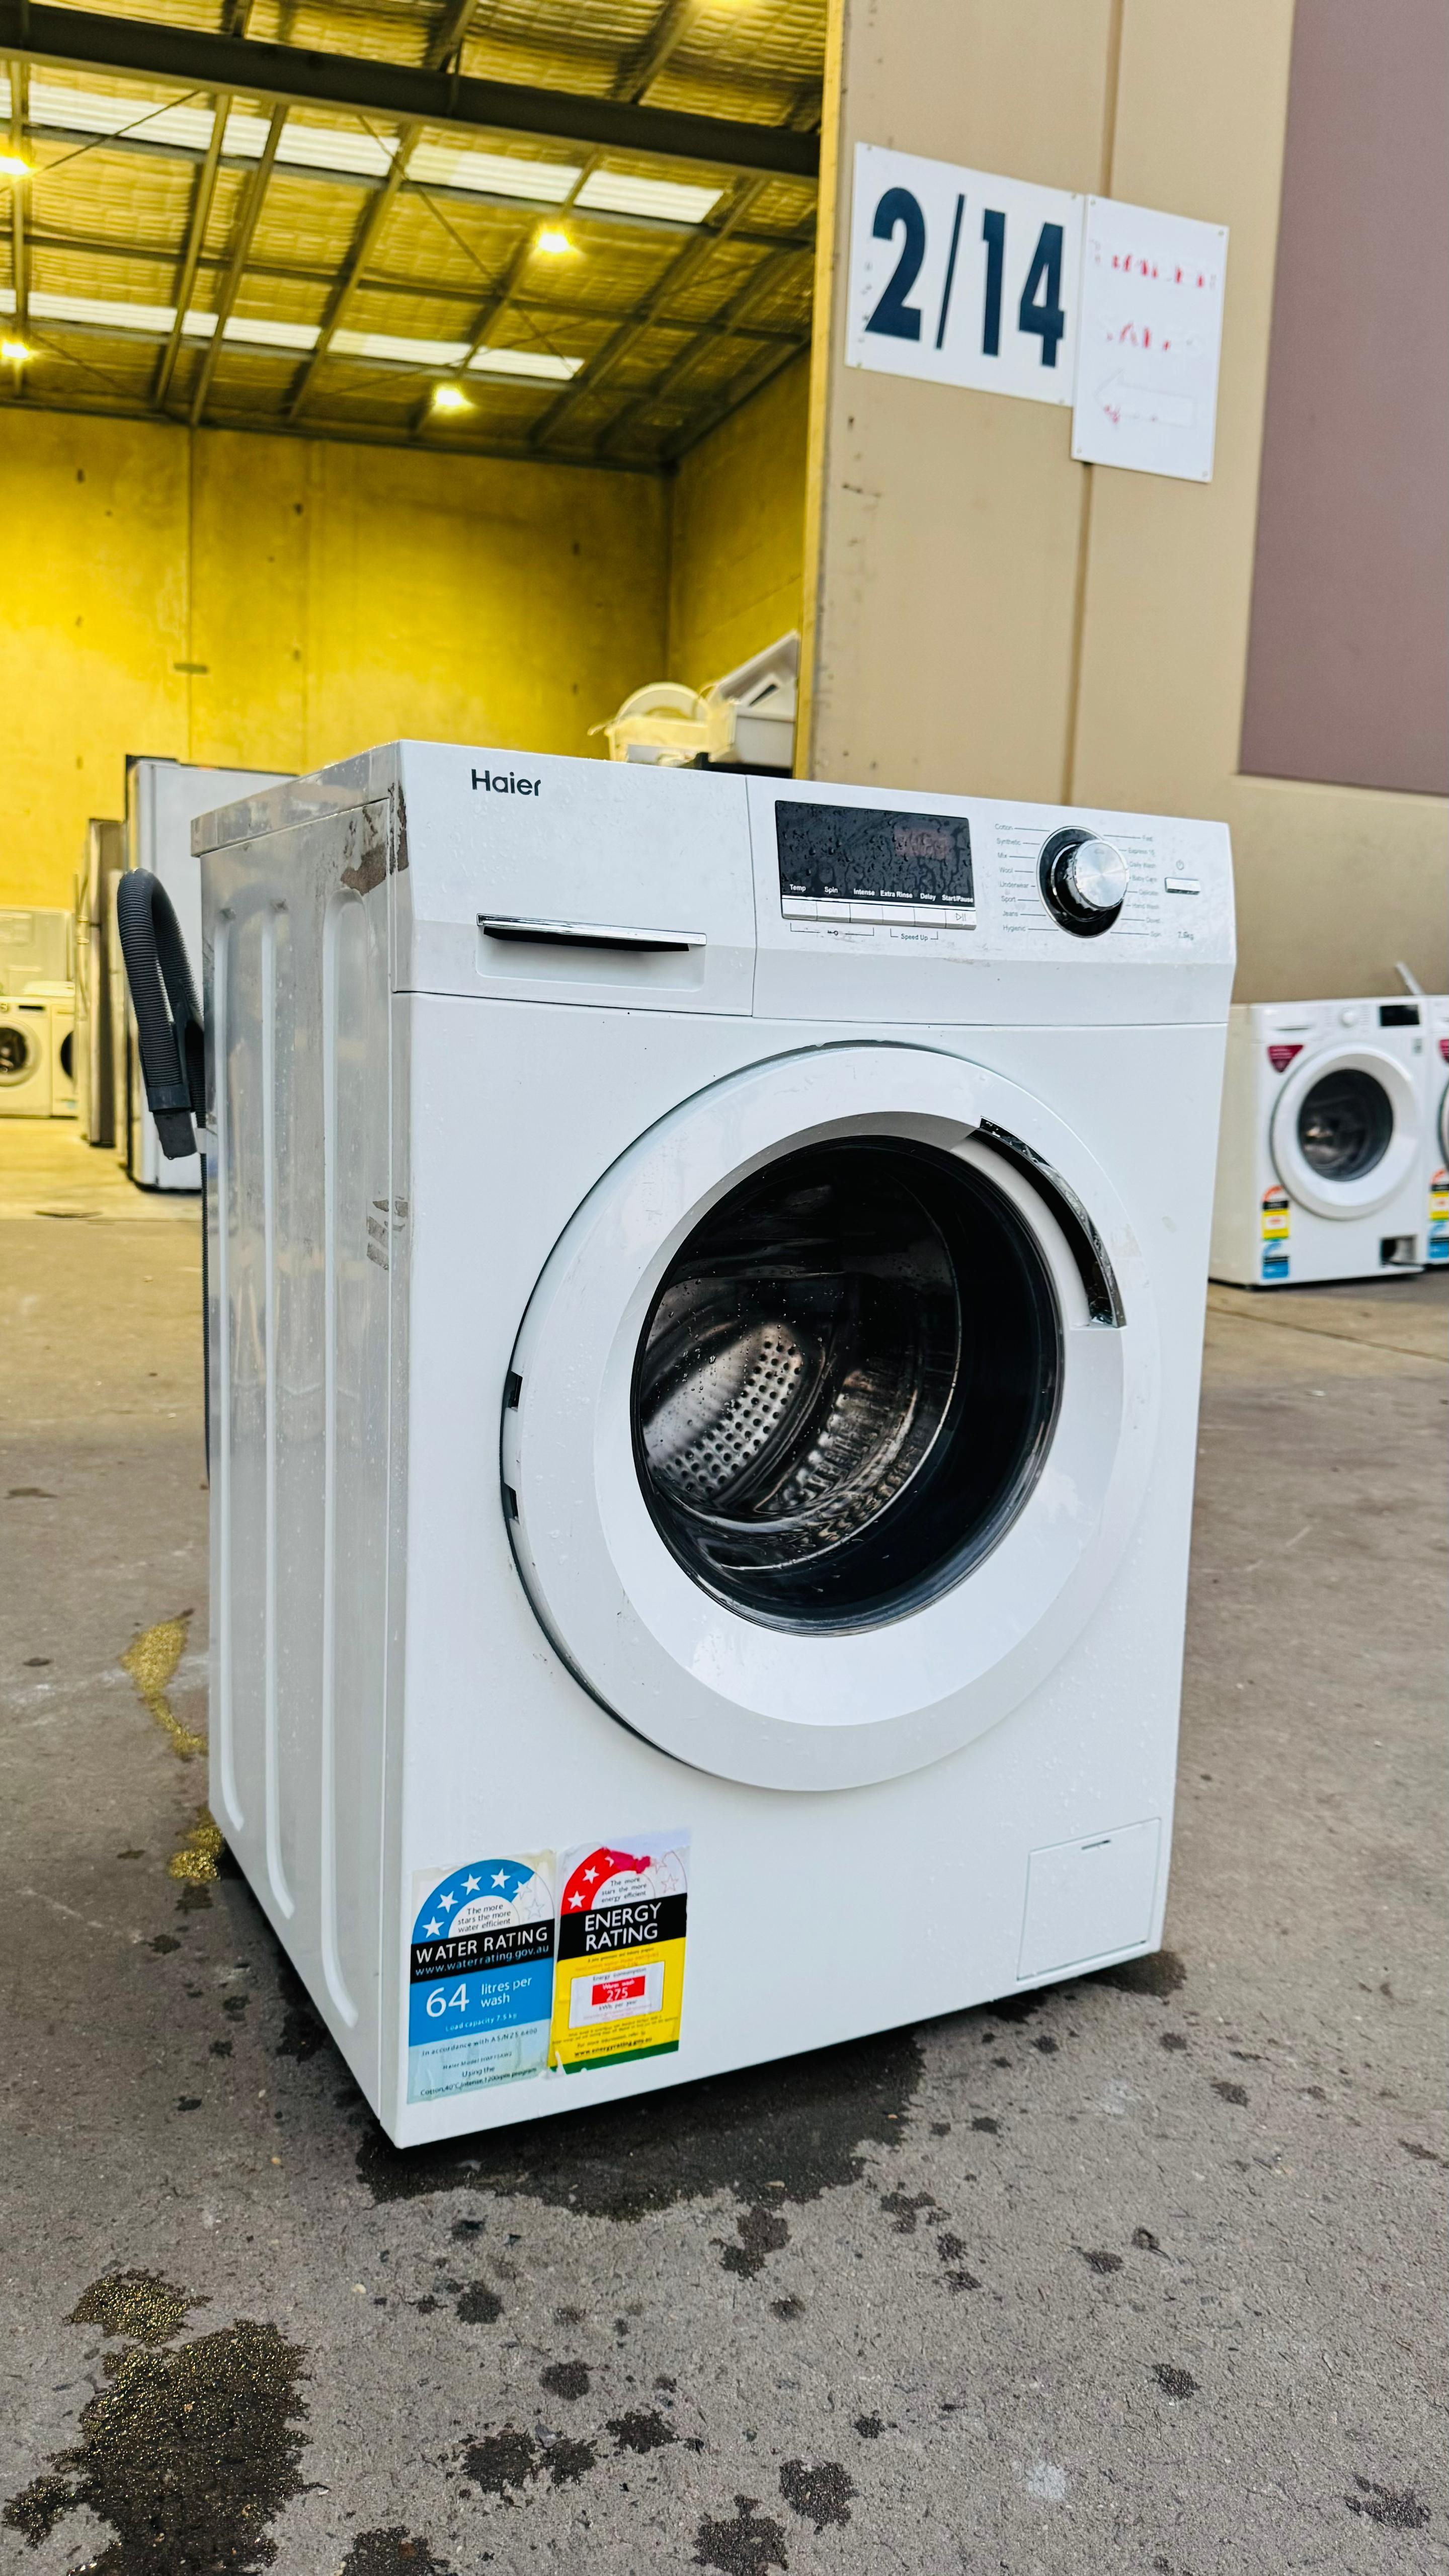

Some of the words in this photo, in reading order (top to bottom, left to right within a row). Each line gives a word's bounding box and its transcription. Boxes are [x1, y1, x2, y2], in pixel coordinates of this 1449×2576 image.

[864, 187, 1065, 368] 2/14
[471, 769, 541, 796] Haier
[789, 884, 806, 892] Temp
[853, 888, 875, 896] Intense
[920, 893, 936, 902] Delay
[942, 894, 974, 903] Start/Pause
[601, 1895, 621, 1903] energy
[624, 1891, 646, 1899] efficient
[484, 1904, 503, 1912] more
[458, 1914, 476, 1925] stars
[477, 1913, 490, 1921] the
[492, 1910, 511, 1919] more
[585, 1902, 662, 1932] ENERGY
[458, 1924, 479, 1933] water
[481, 1918, 511, 1928] efficient
[586, 1922, 658, 1952] RATING
[416, 1940, 477, 1964] WATER
[484, 1926, 548, 1952] RATING
[416, 1944, 549, 1976] www.waterrating.gov.au
[426, 1983, 470, 2018] 64
[481, 1981, 510, 1995] litres
[513, 1977, 532, 1991] per
[481, 1992, 510, 2008] wash
[606, 1986, 628, 2002] 275
[445, 2023, 463, 2032] Load
[464, 2017, 495, 2028] capacity
[431, 2042, 471, 2055] accordance
[473, 2038, 489, 2046] with
[462, 2068, 483, 2077] Using
